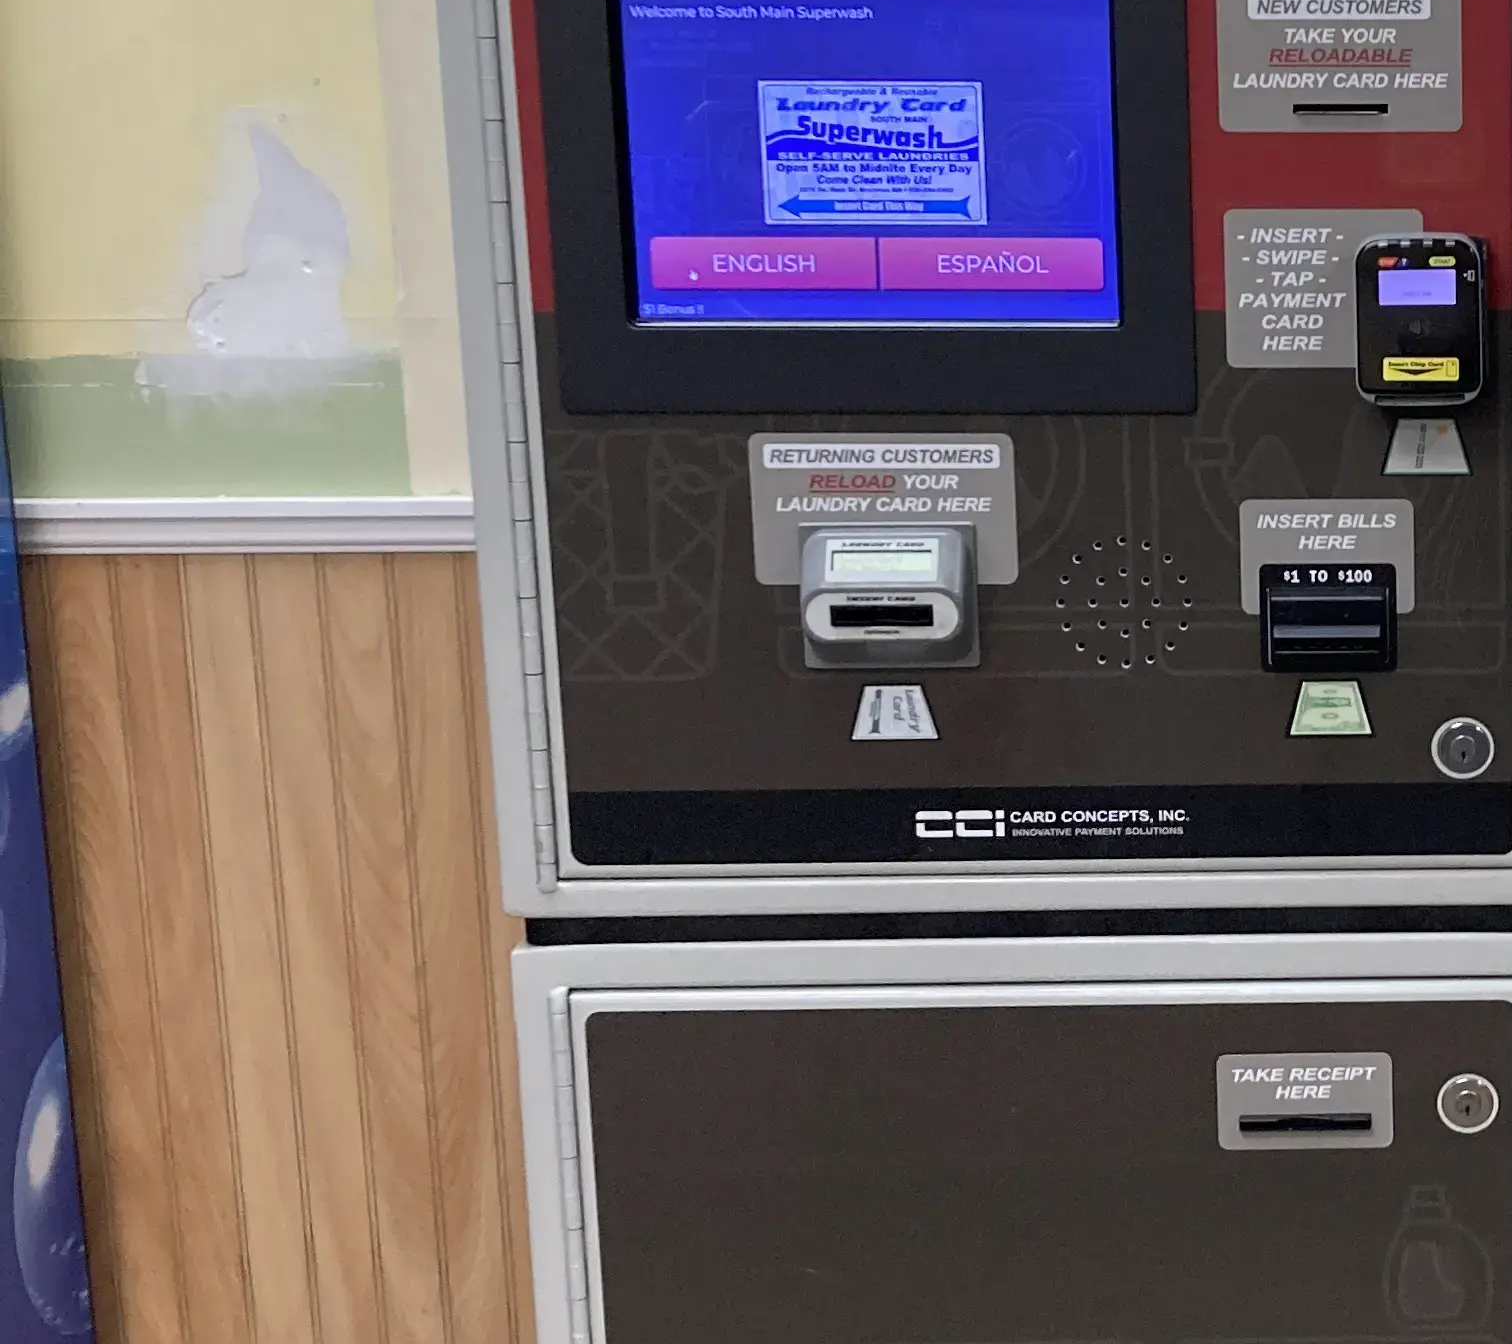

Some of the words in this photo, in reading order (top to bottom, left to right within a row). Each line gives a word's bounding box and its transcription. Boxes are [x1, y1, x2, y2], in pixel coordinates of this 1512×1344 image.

[629, 5, 696, 19] Welcome
[700, 5, 714, 18] to
[716, 5, 757, 18] South
[760, 6, 794, 18] Main
[798, 6, 874, 21] Superwash
[1256, 0, 1301, 14] NEW
[1306, 0, 1423, 14] CUSTOMERS
[1284, 28, 1335, 44] TAKE
[1341, 28, 1396, 44] YOUR
[1268, 48, 1413, 64] RELOADABLE
[1233, 73, 1328, 89] LAUNDRY
[1333, 73, 1388, 89] CARD
[1394, 73, 1448, 88] HERE
[775, 97, 890, 113] Laundry
[901, 98, 967, 112] Card
[797, 115, 943, 149] Superwash
[778, 152, 873, 160] SELF-SERVE
[878, 152, 969, 160] LAUNDRIES
[776, 164, 808, 174] Open
[812, 164, 839, 173] 5AM
[844, 164, 856, 173] to
[860, 164, 906, 173] Midnite
[910, 164, 944, 175] Every
[949, 164, 972, 175] Day
[817, 175, 848, 184] Come
[852, 175, 882, 184] Clean
[886, 175, 911, 184] With
[914, 175, 932, 184] Us!
[1250, 228, 1332, 243] INSERT
[712, 254, 816, 273] ENGLISH
[936, 250, 1049, 274] ESPAÑOL
[1256, 250, 1327, 265] SWIPE
[1270, 271, 1314, 287] TAP
[1238, 293, 1346, 308] PAYMENT
[1261, 315, 1323, 329] CARD
[1262, 336, 1323, 351] HERE
[770, 449, 874, 463] RETURNING
[881, 449, 994, 464] CUSTOMERS
[809, 474, 896, 489] RELOAD
[903, 474, 959, 489] YOUR
[776, 497, 871, 512] LAUNDRY
[875, 497, 932, 512] CARD
[937, 497, 992, 512] HERE
[1256, 514, 1333, 529] INSERT
[1337, 514, 1396, 529] BILLS
[1298, 535, 1357, 550] HERE
[1283, 570, 1300, 583] $1
[1309, 570, 1328, 583] TO
[1338, 570, 1373, 583] $100
[1010, 811, 1056, 823] CARD
[1060, 810, 1154, 824] CONCEPTS,
[1158, 810, 1190, 823] INC.
[1012, 828, 1072, 837] INNOVATIVE
[1075, 827, 1122, 836] PAYMENT
[1125, 826, 1184, 835] SOLUTIONS
[1231, 1068, 1284, 1083] TAKE
[1289, 1066, 1377, 1082] RECEIPT
[1275, 1085, 1331, 1099] HERE
